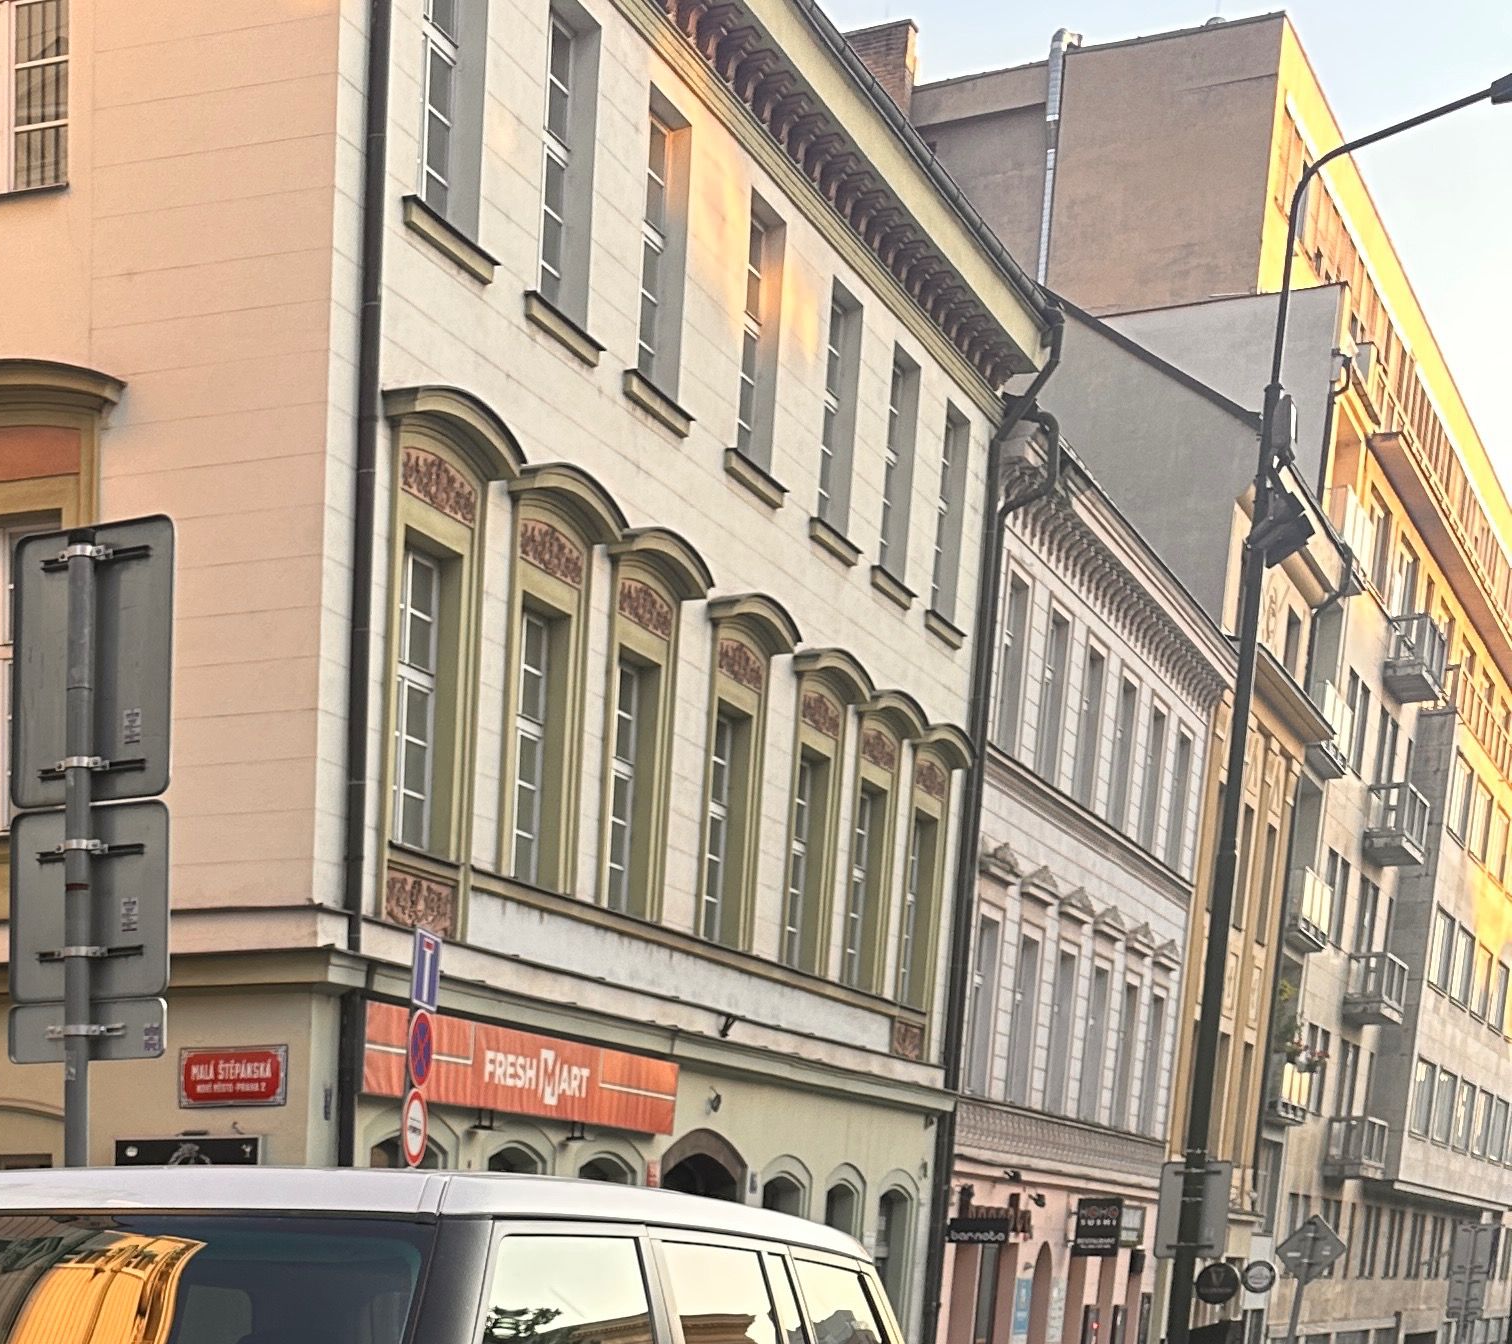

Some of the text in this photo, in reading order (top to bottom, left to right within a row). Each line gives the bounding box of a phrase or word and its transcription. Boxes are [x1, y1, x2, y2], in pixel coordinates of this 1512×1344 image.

[191, 1061, 215, 1080] MALÁ
[484, 1048, 591, 1106] FRESH MART
